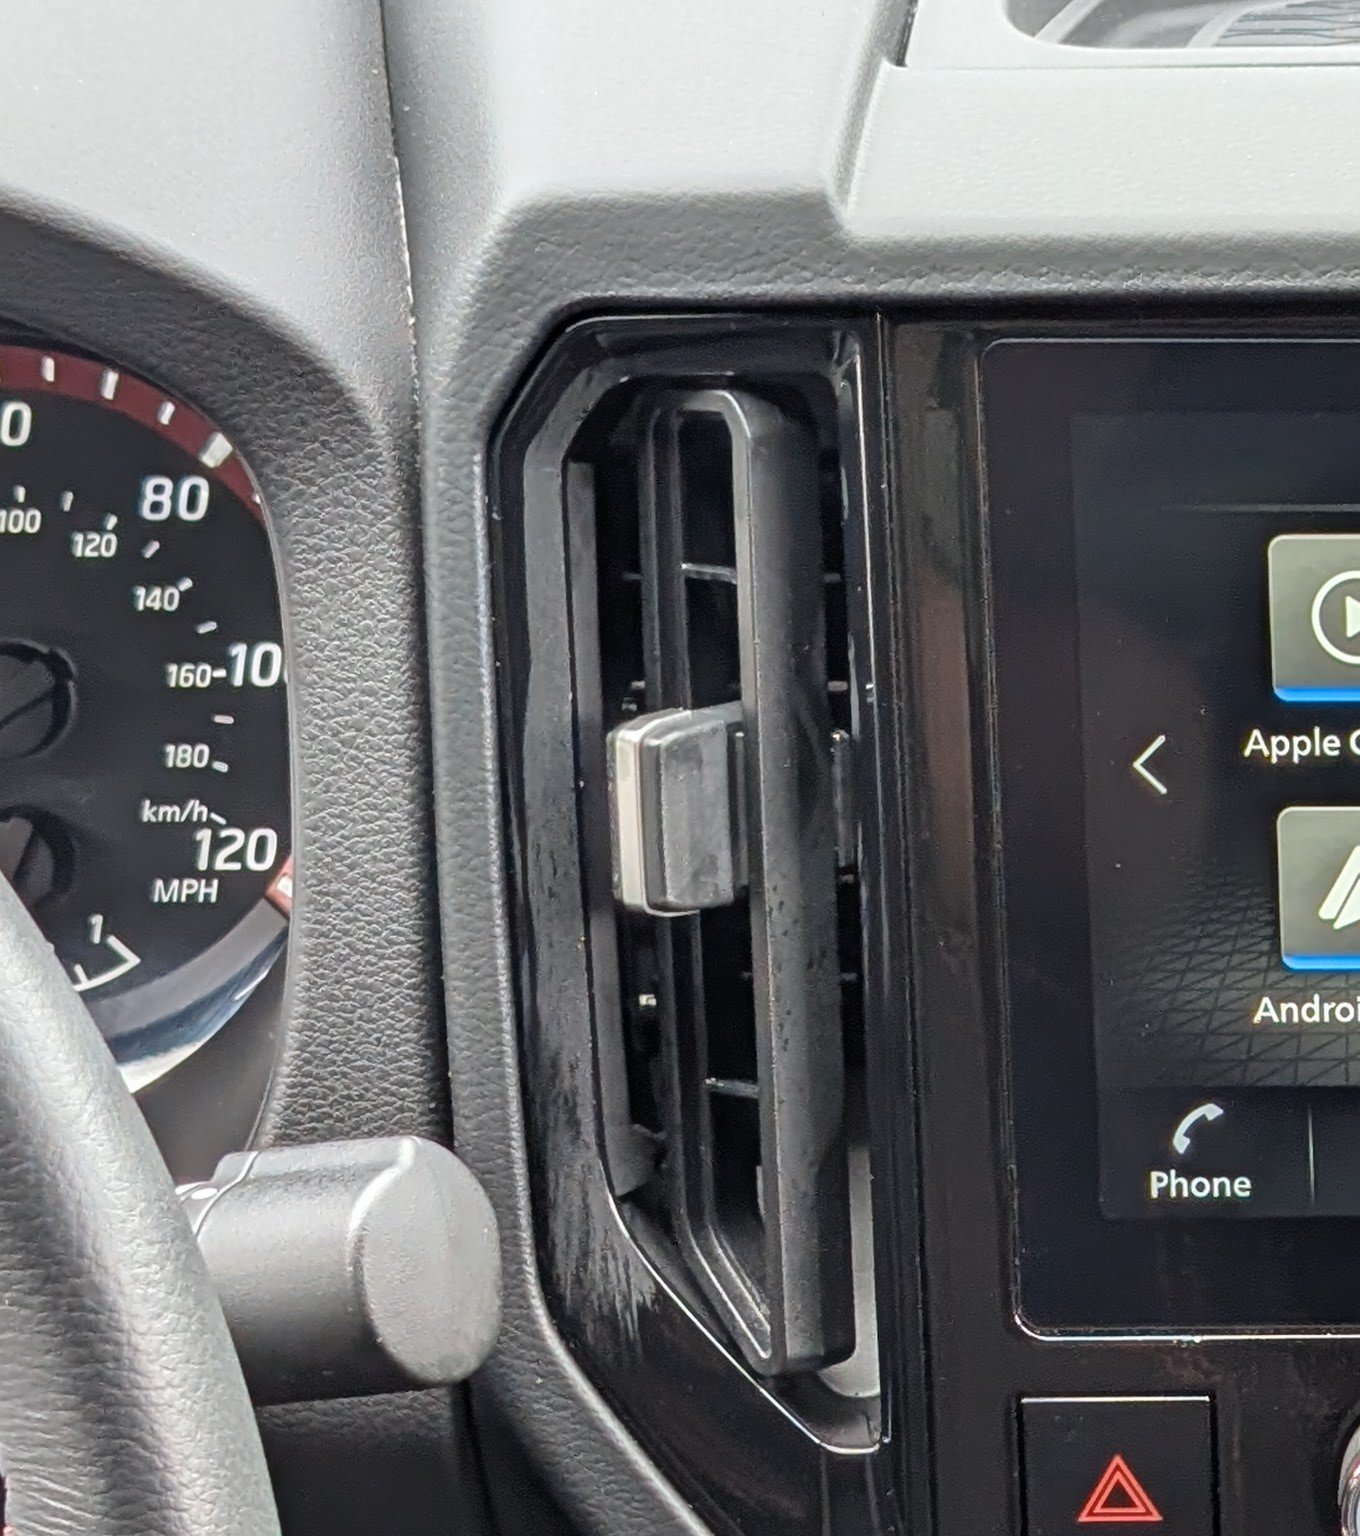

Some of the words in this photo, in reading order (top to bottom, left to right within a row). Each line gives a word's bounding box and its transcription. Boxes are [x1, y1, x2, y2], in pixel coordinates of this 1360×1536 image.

[137, 474, 212, 522] 80
[70, 530, 119, 559] 120
[133, 584, 182, 613] 140
[165, 661, 213, 689] 160
[227, 641, 288, 688] 10
[163, 743, 210, 769] 180
[1243, 726, 1342, 764] Apple
[140, 798, 209, 824] km/h
[194, 826, 278, 872] 120
[151, 877, 219, 904] MPH
[1149, 1169, 1253, 1199] Phone
